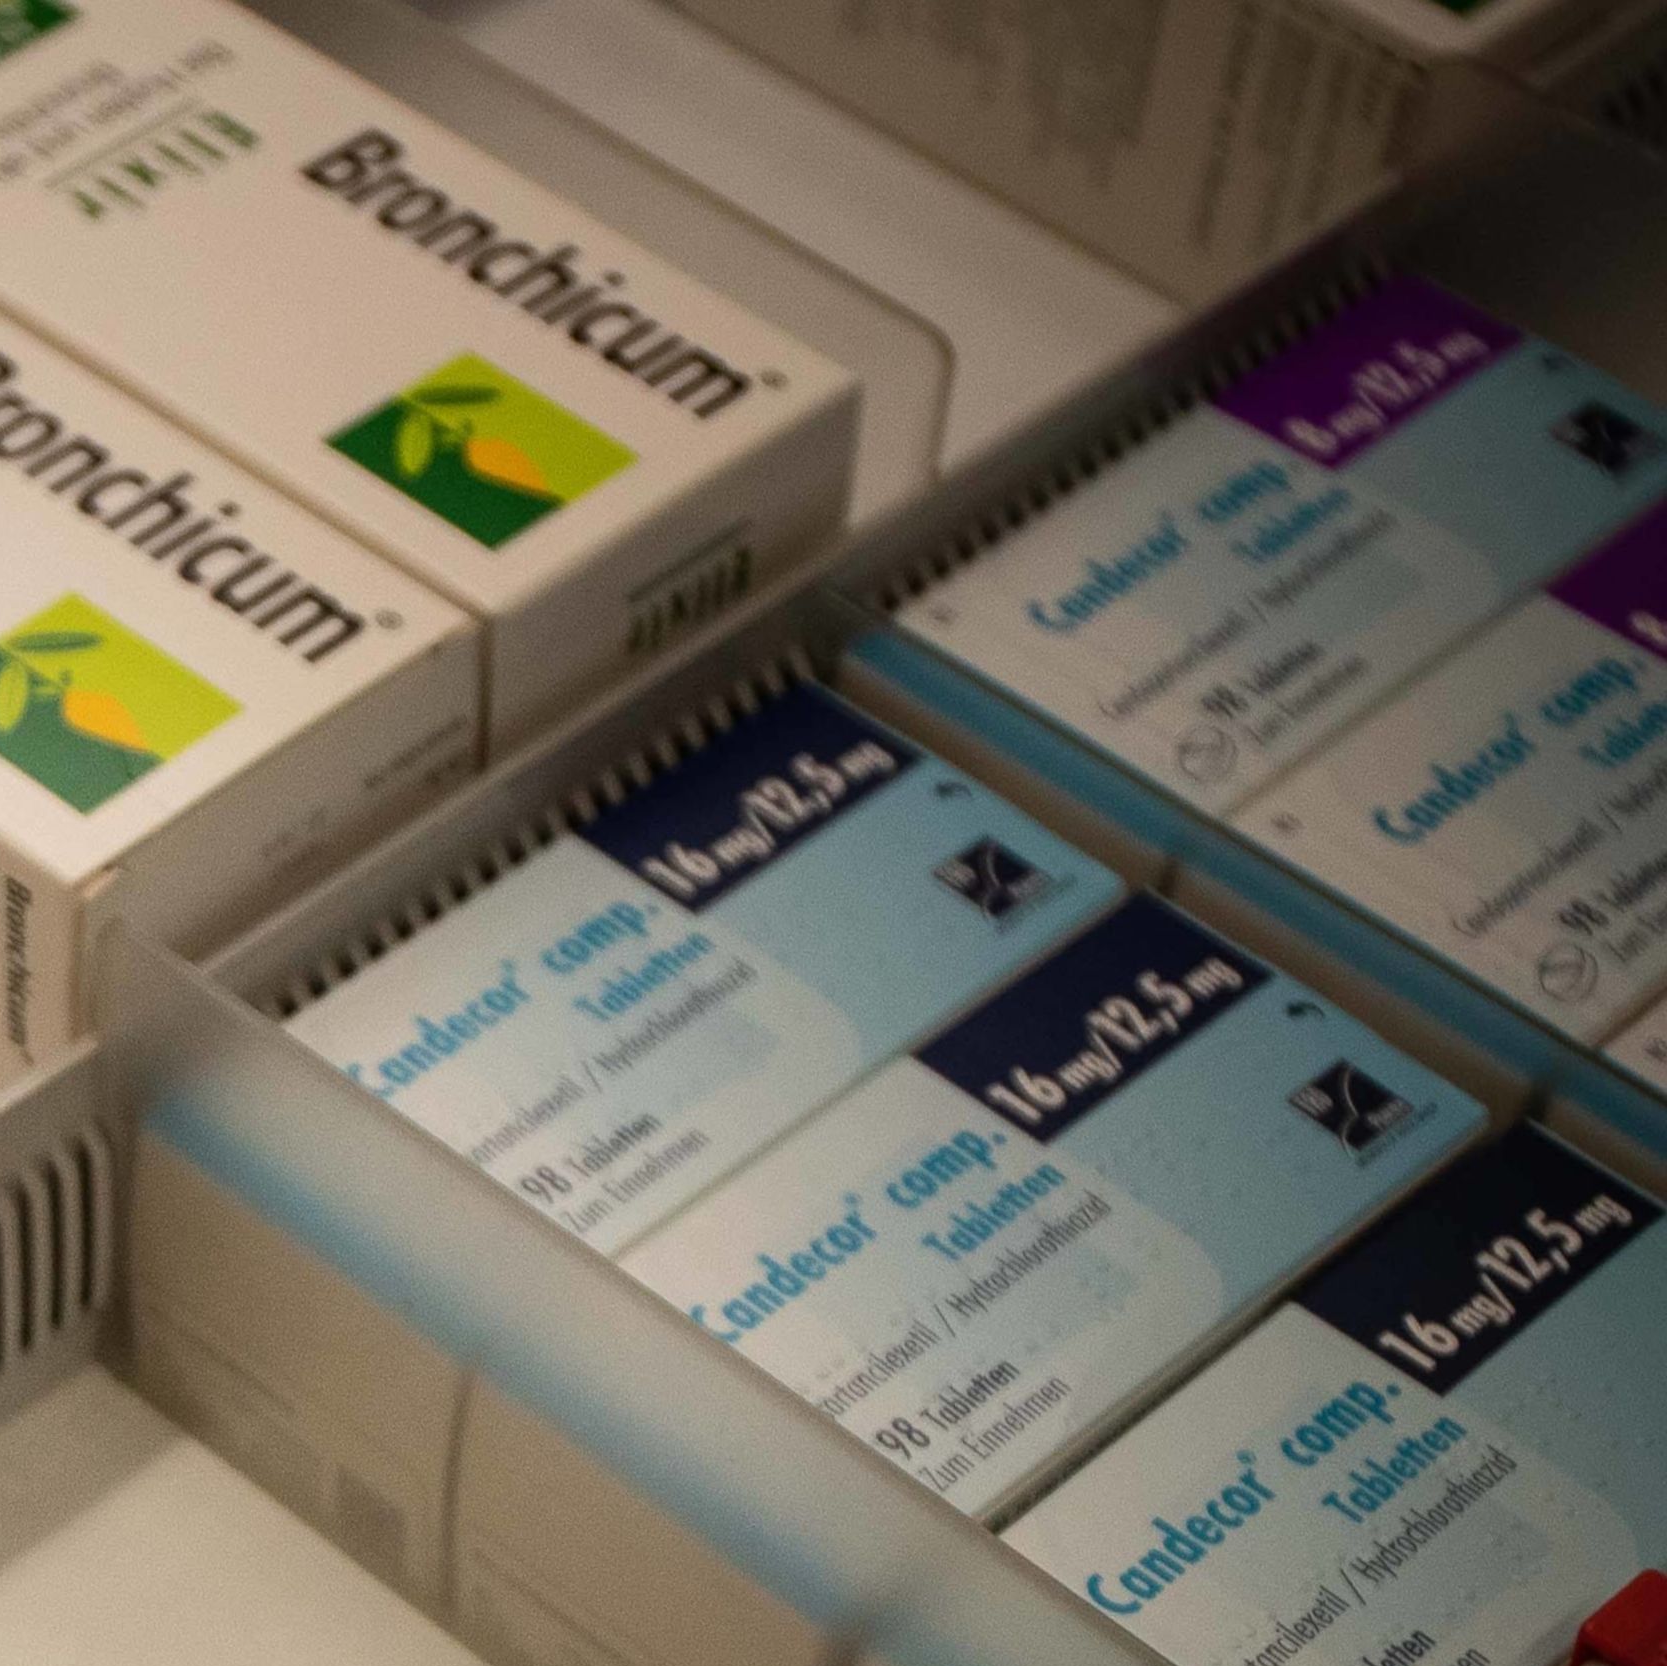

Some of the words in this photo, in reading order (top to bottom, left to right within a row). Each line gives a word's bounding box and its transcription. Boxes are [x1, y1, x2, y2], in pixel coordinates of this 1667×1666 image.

[639, 839, 721, 901] 16
[838, 737, 898, 783] mg
[570, 930, 715, 1023] Tabletten
[985, 1067, 1068, 1125] 16
[1182, 955, 1244, 1000] mg
[518, 1162, 575, 1206] 98
[883, 1128, 1007, 1210] comp.
[919, 1160, 1069, 1264] Tabletten
[1378, 1309, 1461, 1374] 16
[1574, 1193, 1634, 1238] mg
[876, 1415, 931, 1462] 98
[920, 1357, 1022, 1434] Tabletten
[1279, 1371, 1404, 1471] comp.
[918, 1445, 974, 1496] Zum
[1321, 1410, 1467, 1526] Tabletten
[1353, 1444, 1520, 1587] Hydrochlorothiazid
